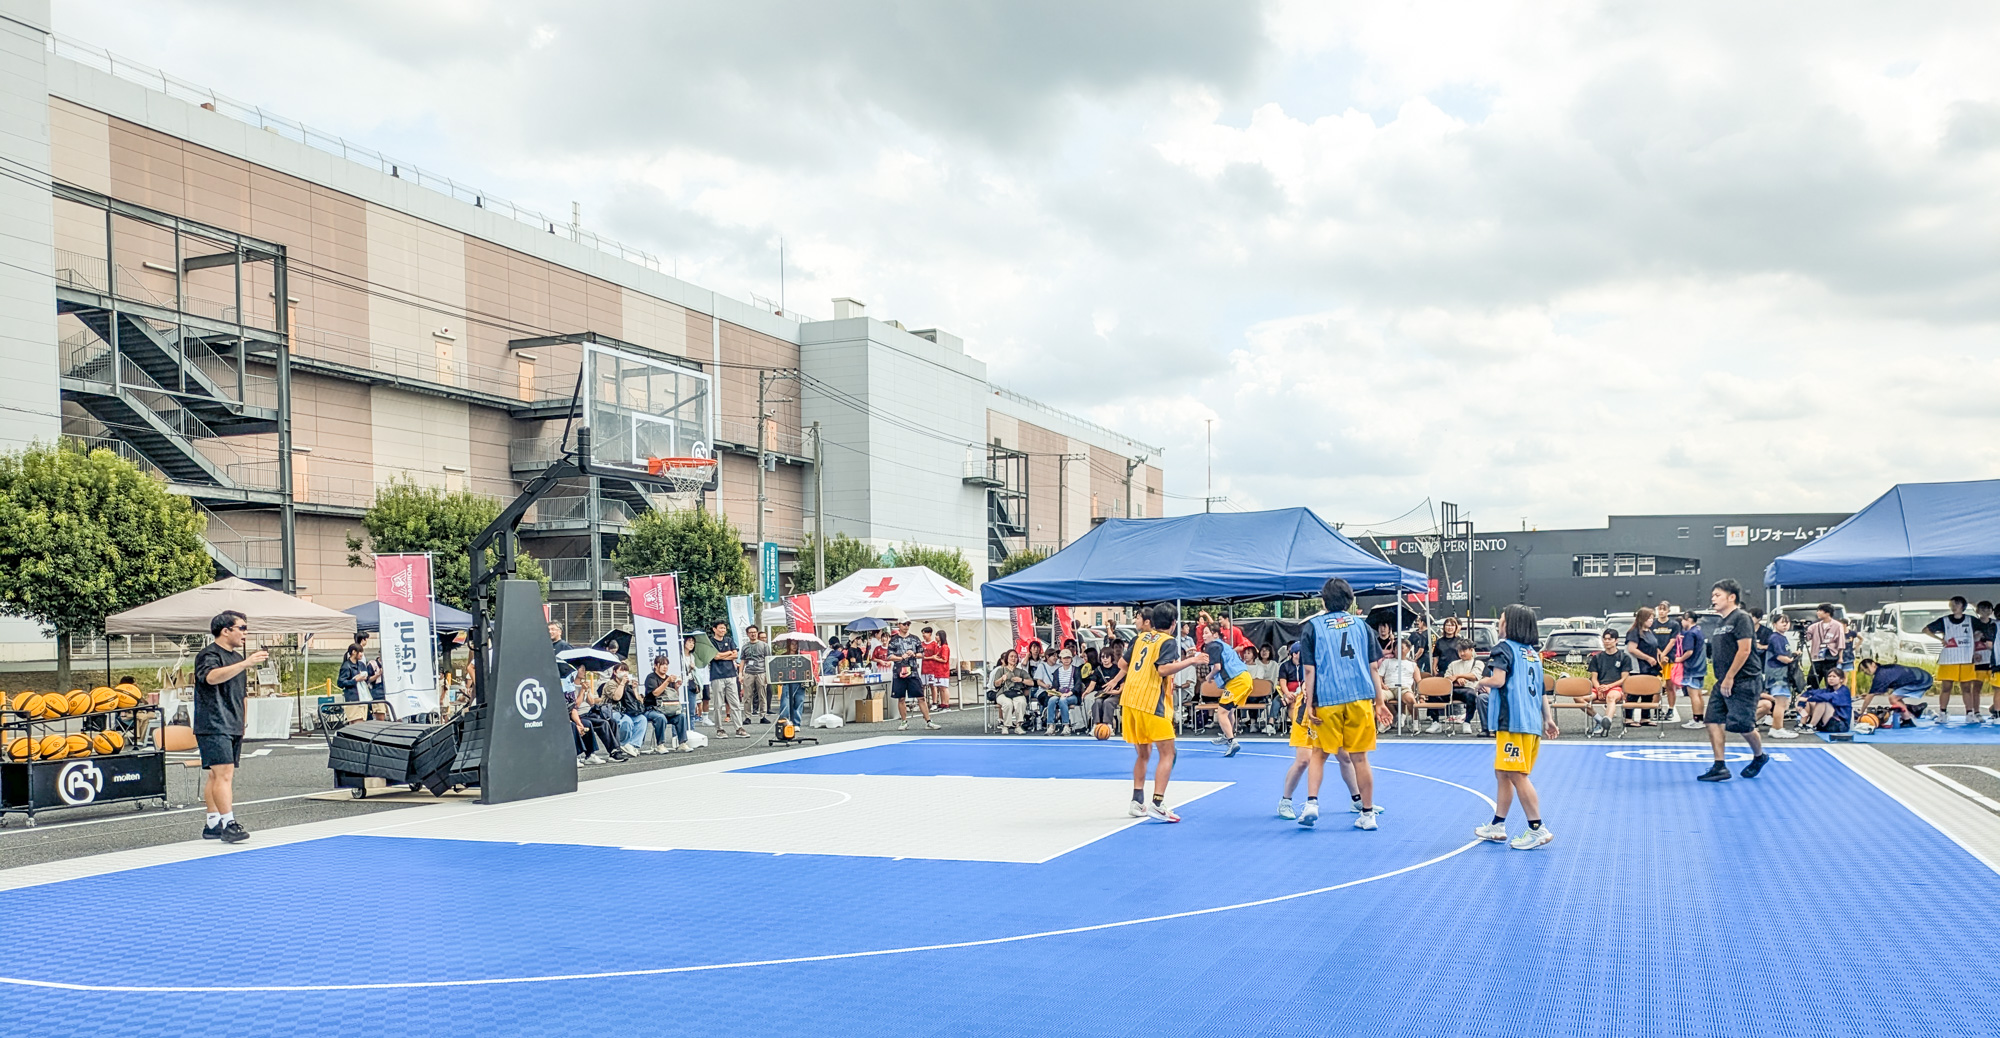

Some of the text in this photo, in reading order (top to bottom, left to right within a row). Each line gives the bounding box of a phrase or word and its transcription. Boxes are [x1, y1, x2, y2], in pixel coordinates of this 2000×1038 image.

[1399, 542, 1440, 553] CENO
[1341, 632, 1356, 659] 4
[1135, 646, 1148, 671] 3
[1528, 666, 1537, 697] 3
[524, 720, 543, 728] molten
[1504, 742, 1520, 757] GR
[113, 773, 141, 783] molten
